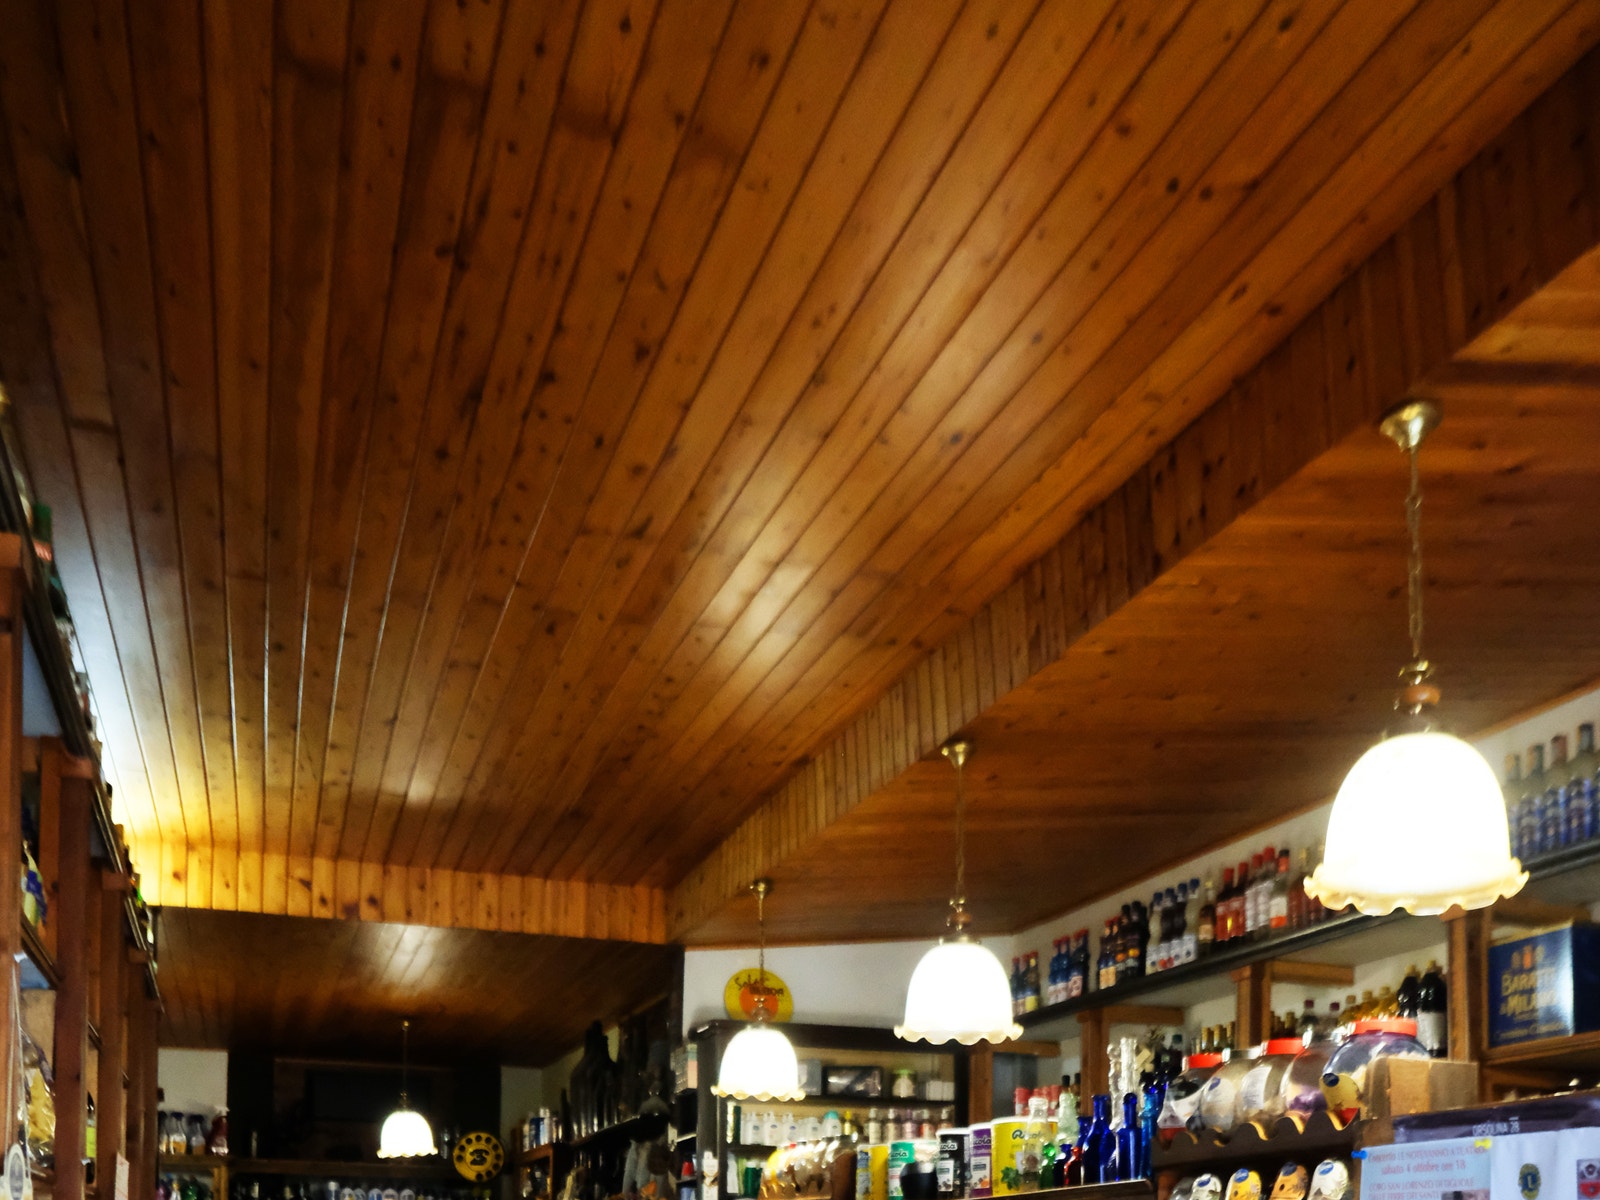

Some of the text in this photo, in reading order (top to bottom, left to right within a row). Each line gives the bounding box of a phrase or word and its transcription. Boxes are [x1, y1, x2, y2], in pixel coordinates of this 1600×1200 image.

[1510, 1120, 1520, 1134] 28
[1413, 1161, 1439, 1172] ottobre
[1456, 1159, 1466, 1169] 18
